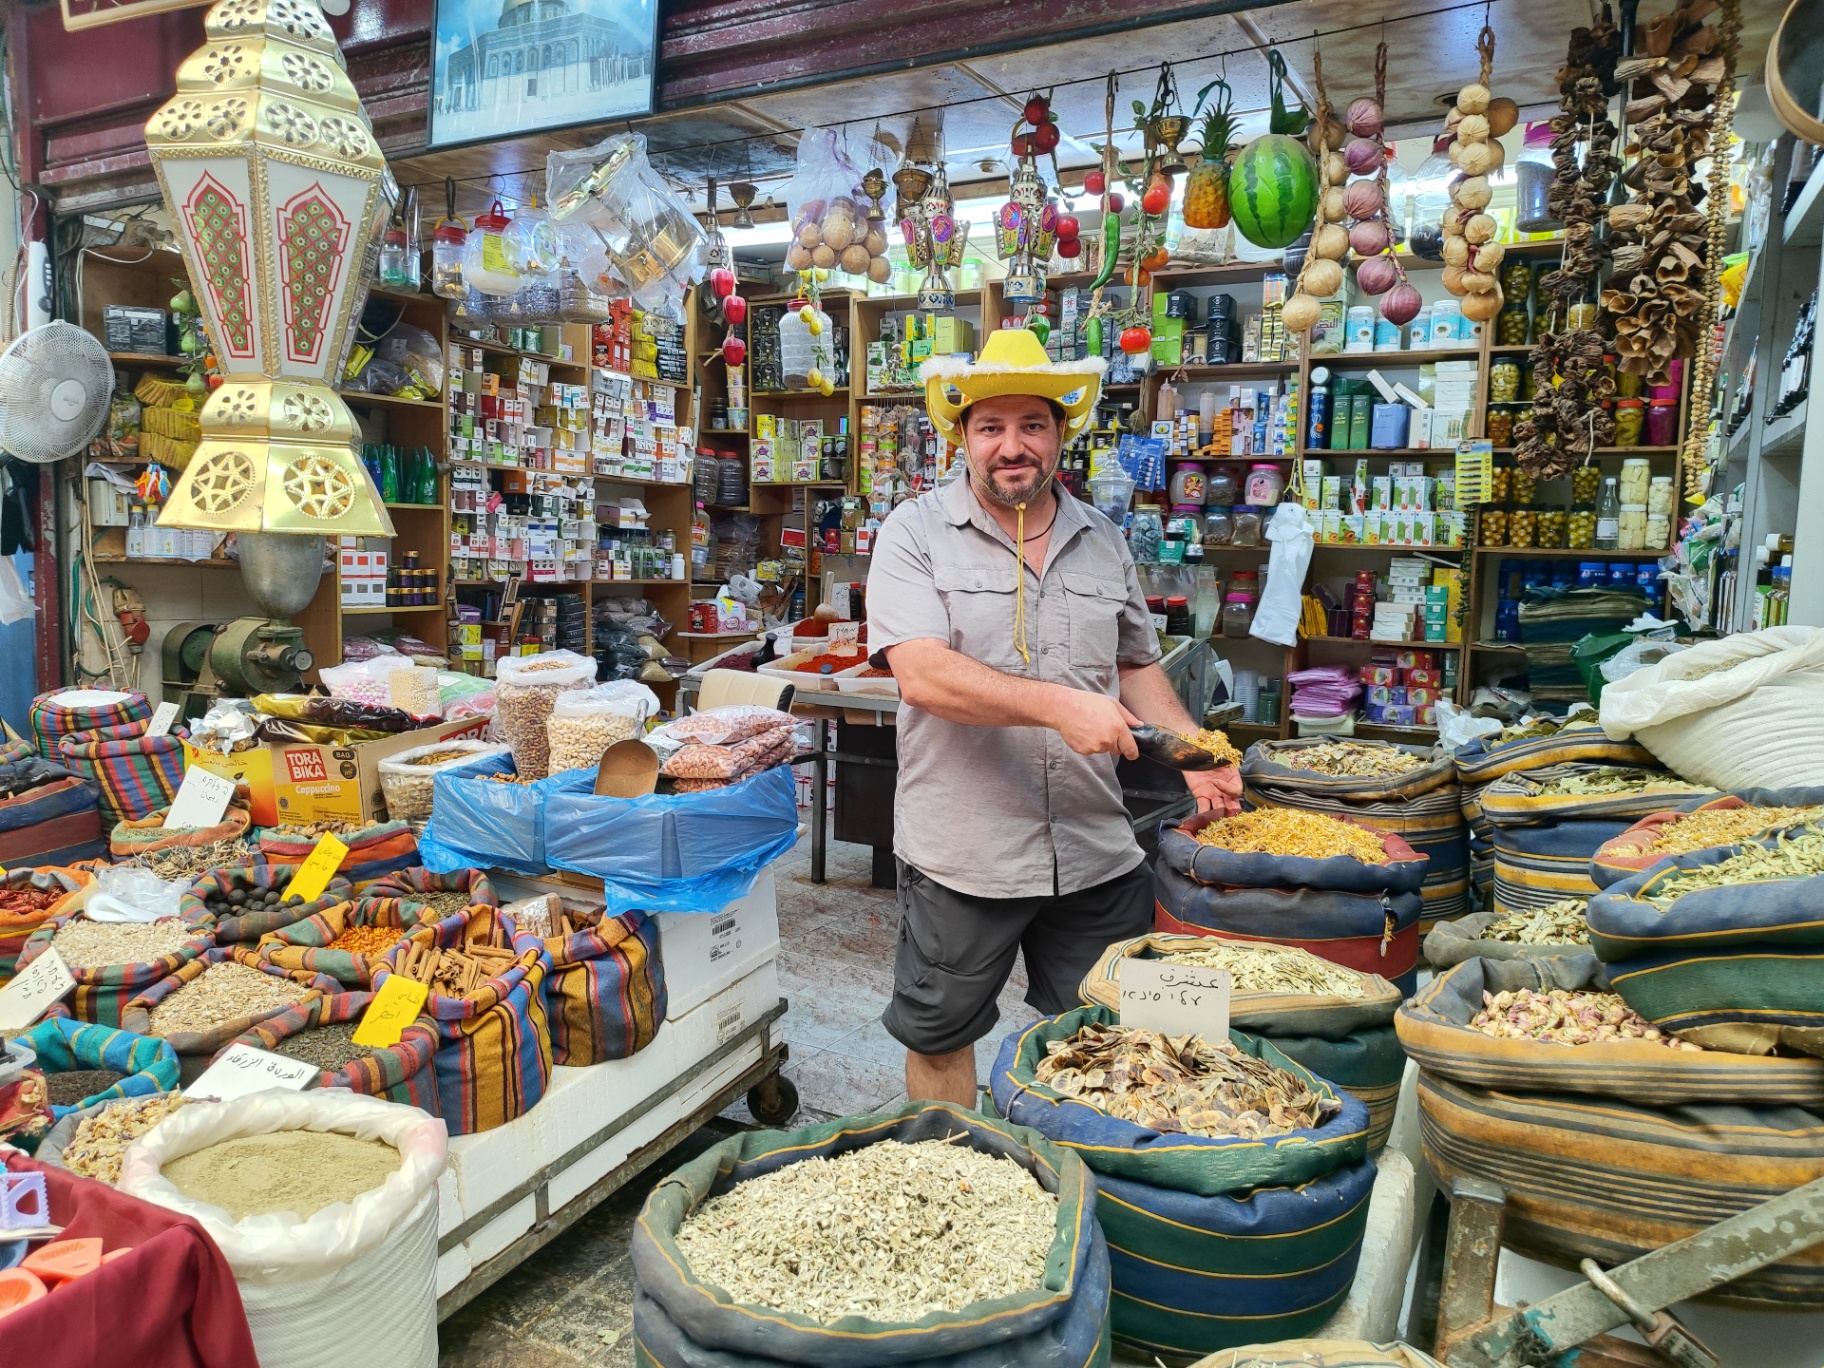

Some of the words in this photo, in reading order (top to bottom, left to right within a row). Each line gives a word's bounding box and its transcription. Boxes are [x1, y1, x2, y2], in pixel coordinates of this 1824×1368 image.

[442, 724, 490, 743] ORA
[286, 752, 322, 766] TORA
[292, 764, 325, 779] BIKA
[295, 783, 340, 795] Cappuccino
